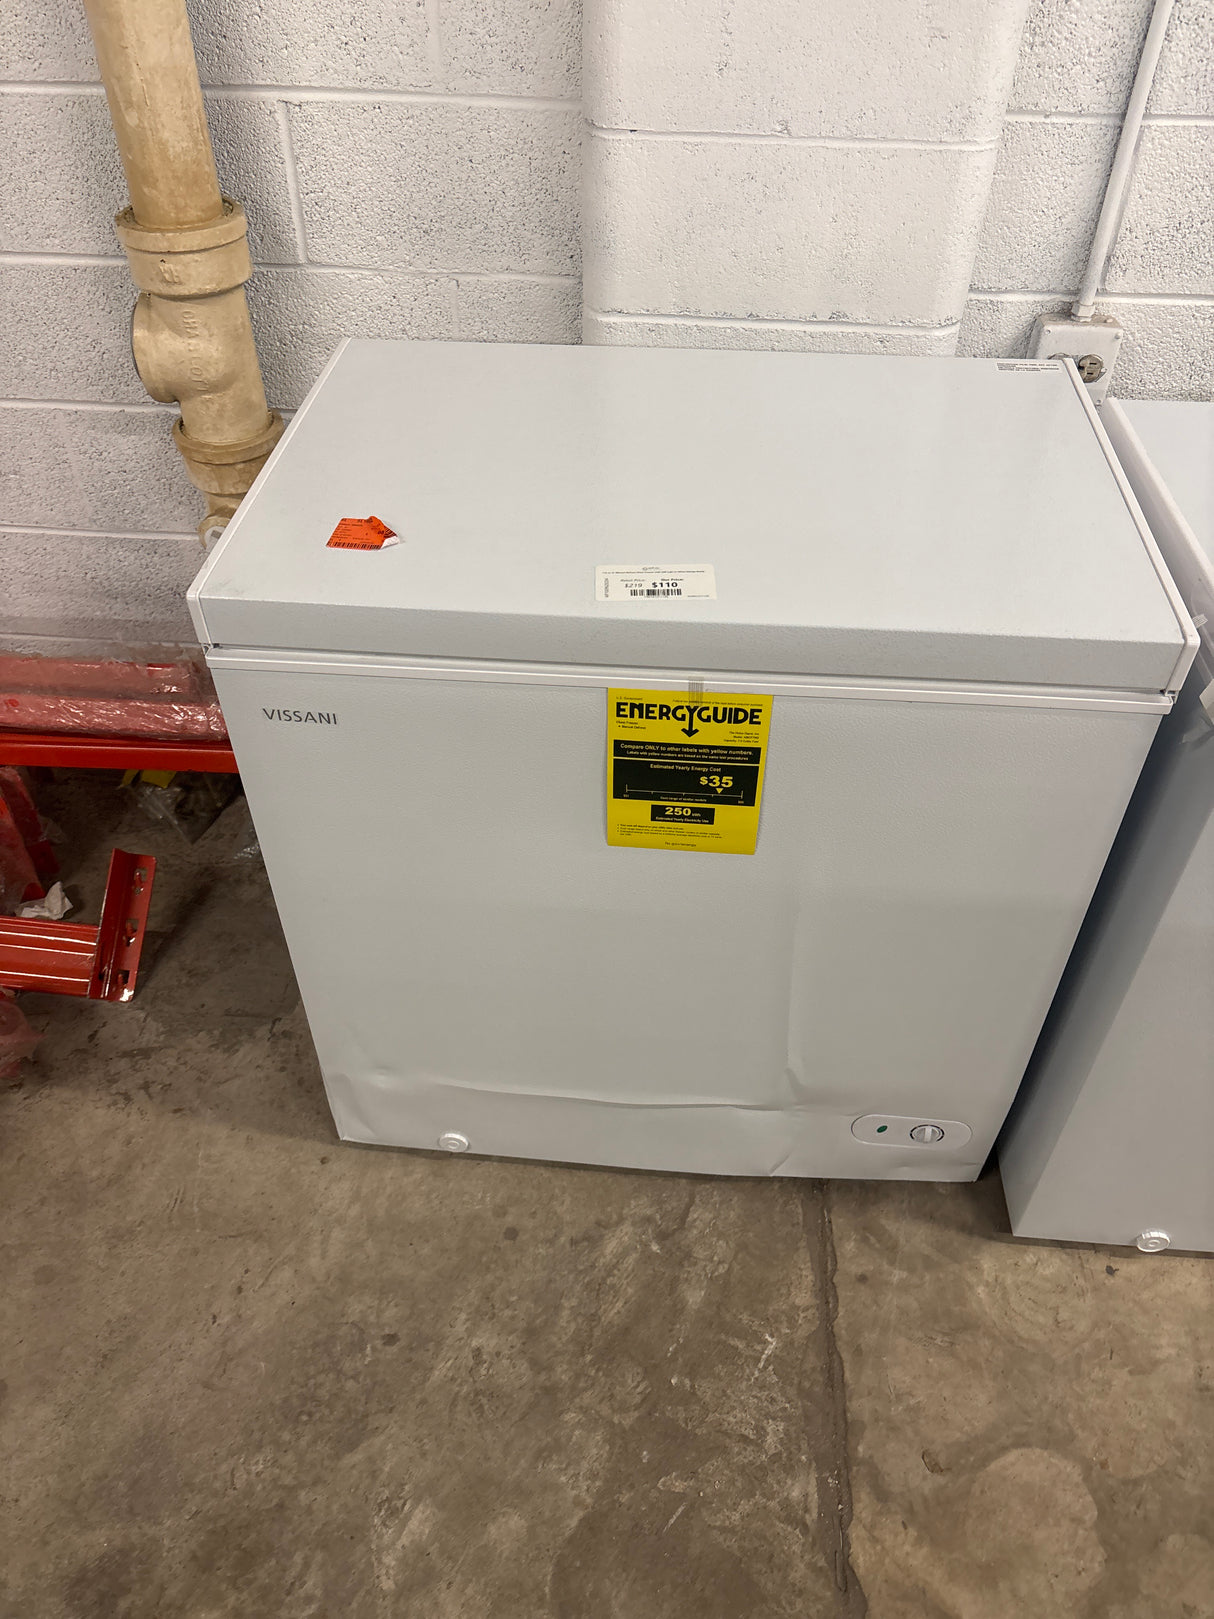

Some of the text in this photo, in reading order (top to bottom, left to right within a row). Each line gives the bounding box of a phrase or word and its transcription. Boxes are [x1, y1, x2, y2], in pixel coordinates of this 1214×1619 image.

[262, 708, 337, 725] VISSANI
[615, 701, 763, 728] ENERGYGUIDE
[710, 748, 728, 756] yellow
[690, 765, 708, 773] Energy
[699, 775, 734, 788] $35
[664, 806, 691, 817] 250
